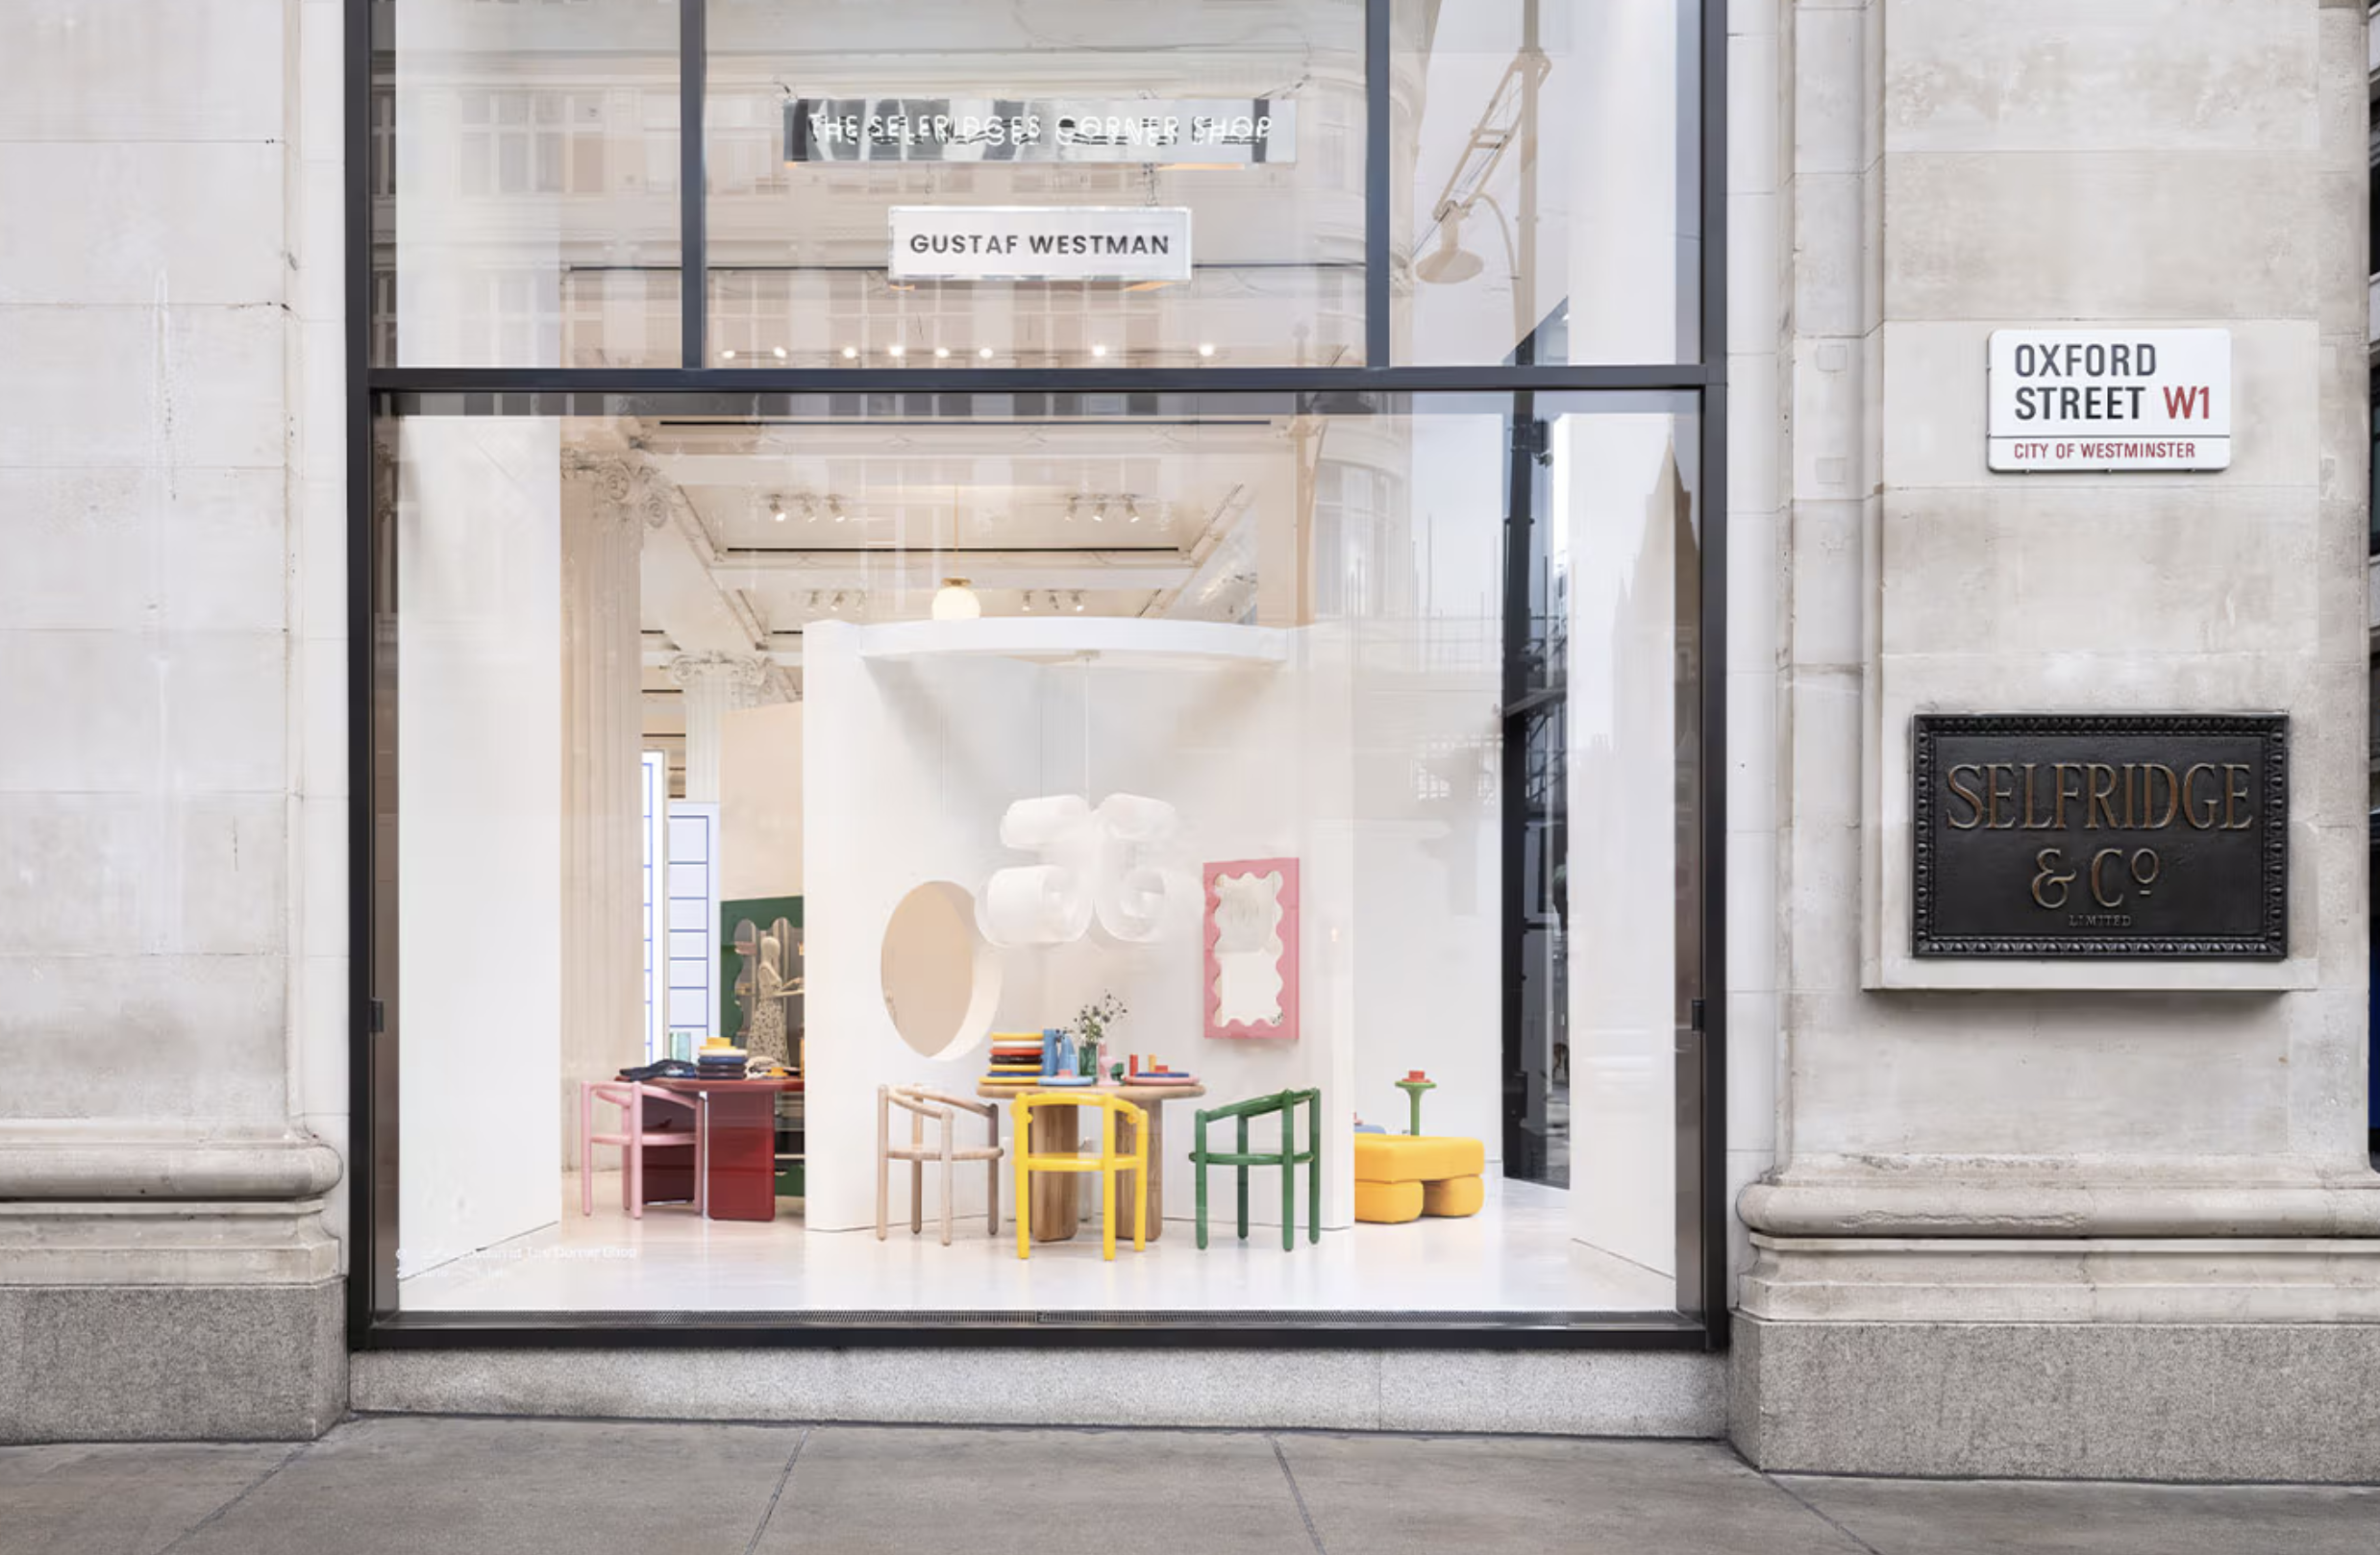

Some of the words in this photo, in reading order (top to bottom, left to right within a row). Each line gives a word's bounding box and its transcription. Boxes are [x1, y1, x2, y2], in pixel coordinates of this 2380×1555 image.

[808, 113, 858, 144] THE
[869, 114, 1041, 145] SELFRIDGES
[1055, 115, 1179, 145] CORNER
[1192, 115, 1273, 144] SHOP
[909, 234, 1019, 255] GUSTAF
[1029, 234, 1170, 255] WESTMAN
[2014, 343, 2157, 378] OXFORD
[2014, 385, 2146, 420] STREET
[2162, 385, 2210, 420] W1
[2014, 443, 2049, 458] CITY
[2055, 443, 2075, 458] OF
[2080, 441, 2195, 458] WESTMINSTER
[1946, 762, 2253, 830] SELFRIDGE
[2031, 848, 2077, 909] &
[2068, 914, 2132, 927] LIMITED
